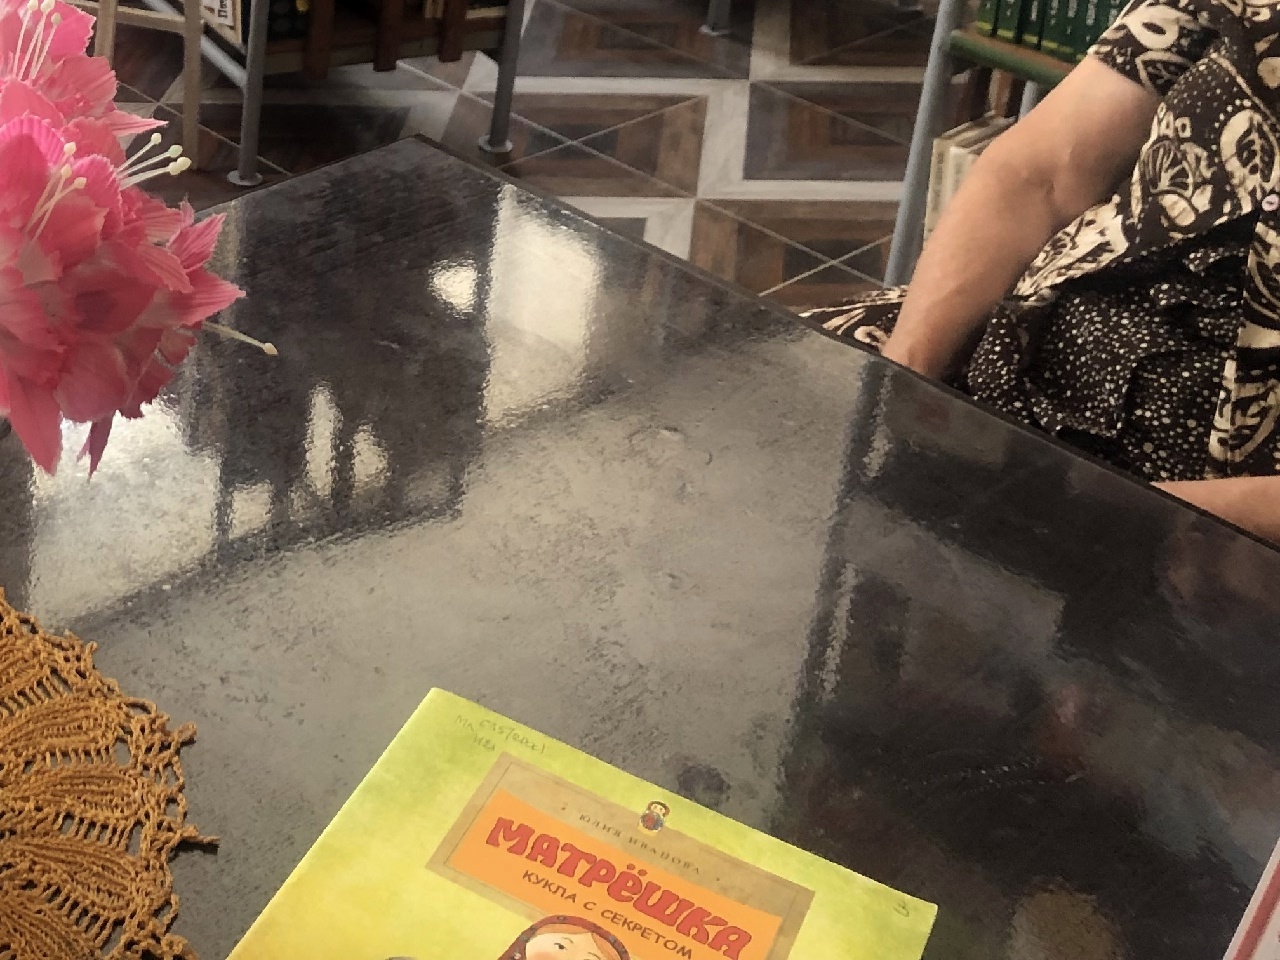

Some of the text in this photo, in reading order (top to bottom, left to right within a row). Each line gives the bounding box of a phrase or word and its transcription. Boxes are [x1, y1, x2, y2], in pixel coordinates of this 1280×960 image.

[486, 816, 752, 960] МАТРЁШКА
[579, 814, 699, 875] ЮЛИЯ ИВАНОВА
[522, 870, 693, 960] КУКЛА С СЕКРЕТОМ
